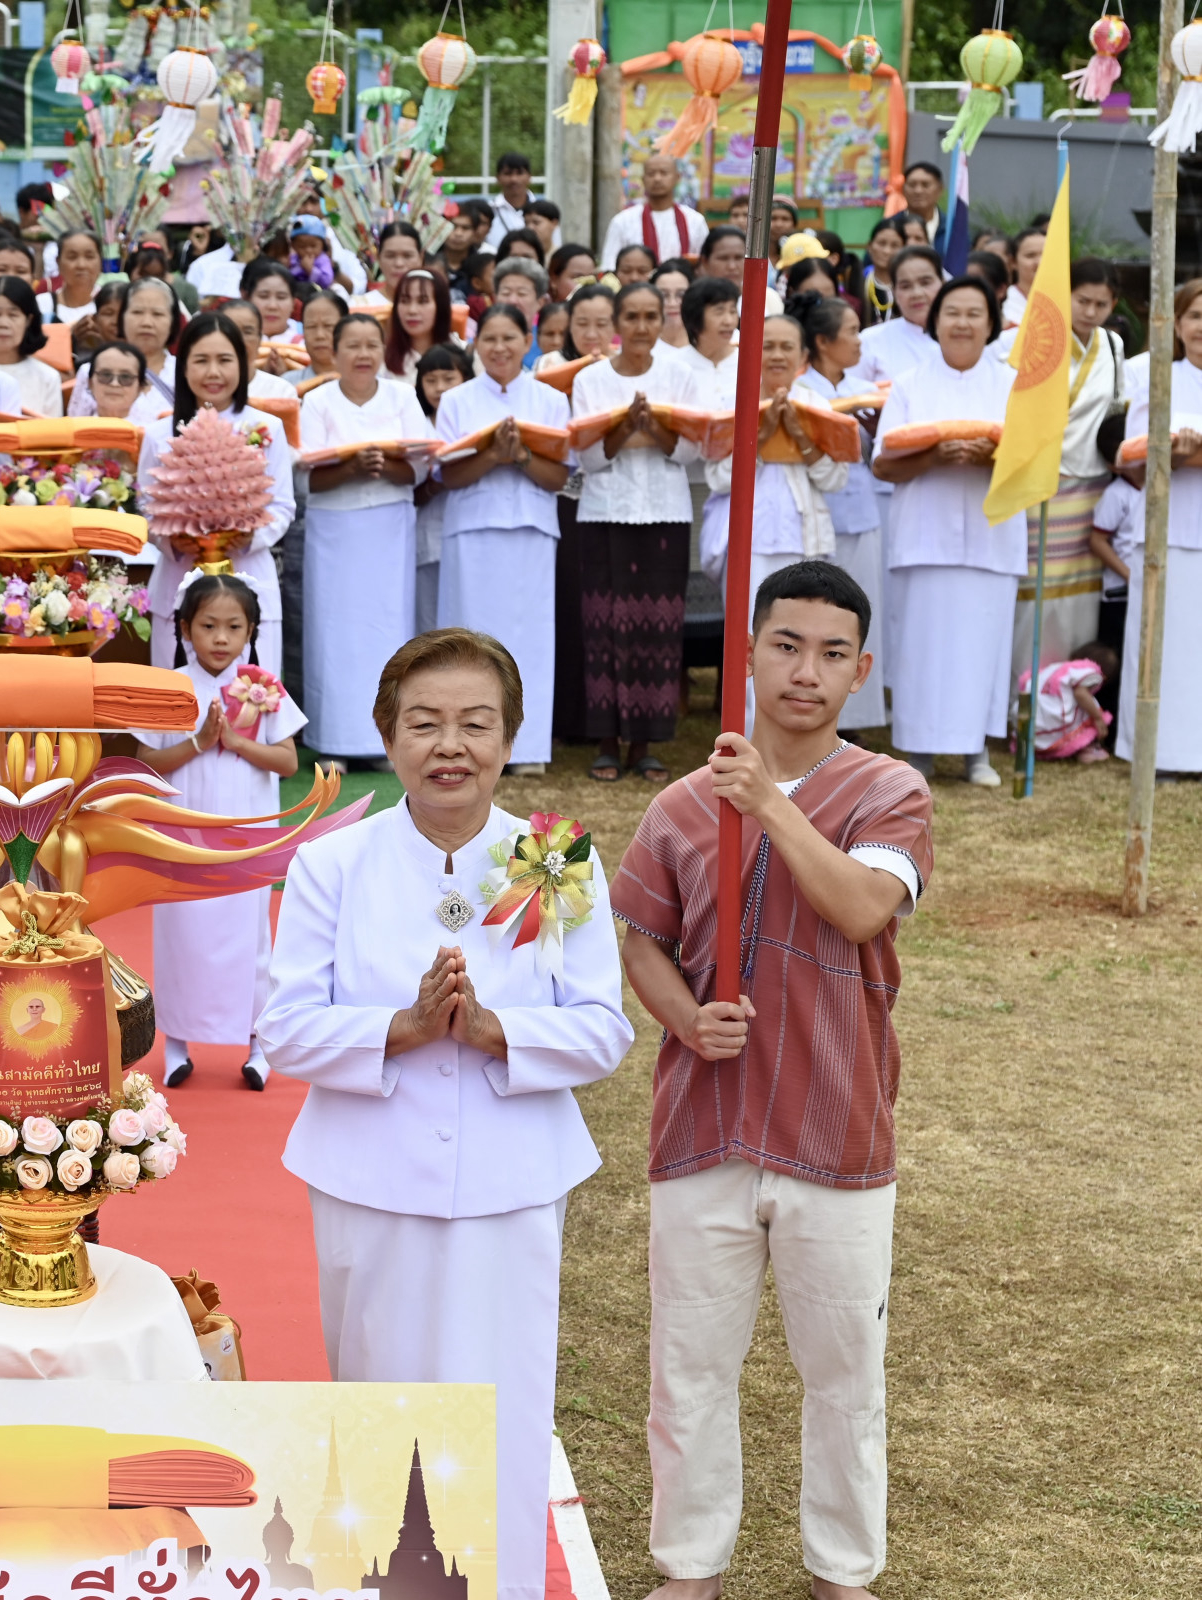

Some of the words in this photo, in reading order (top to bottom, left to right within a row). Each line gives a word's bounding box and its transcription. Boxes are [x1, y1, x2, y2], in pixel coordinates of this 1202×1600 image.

[11, 1087, 23, 1097] วัด
[25, 1086, 73, 1099] พุทธศักราช
